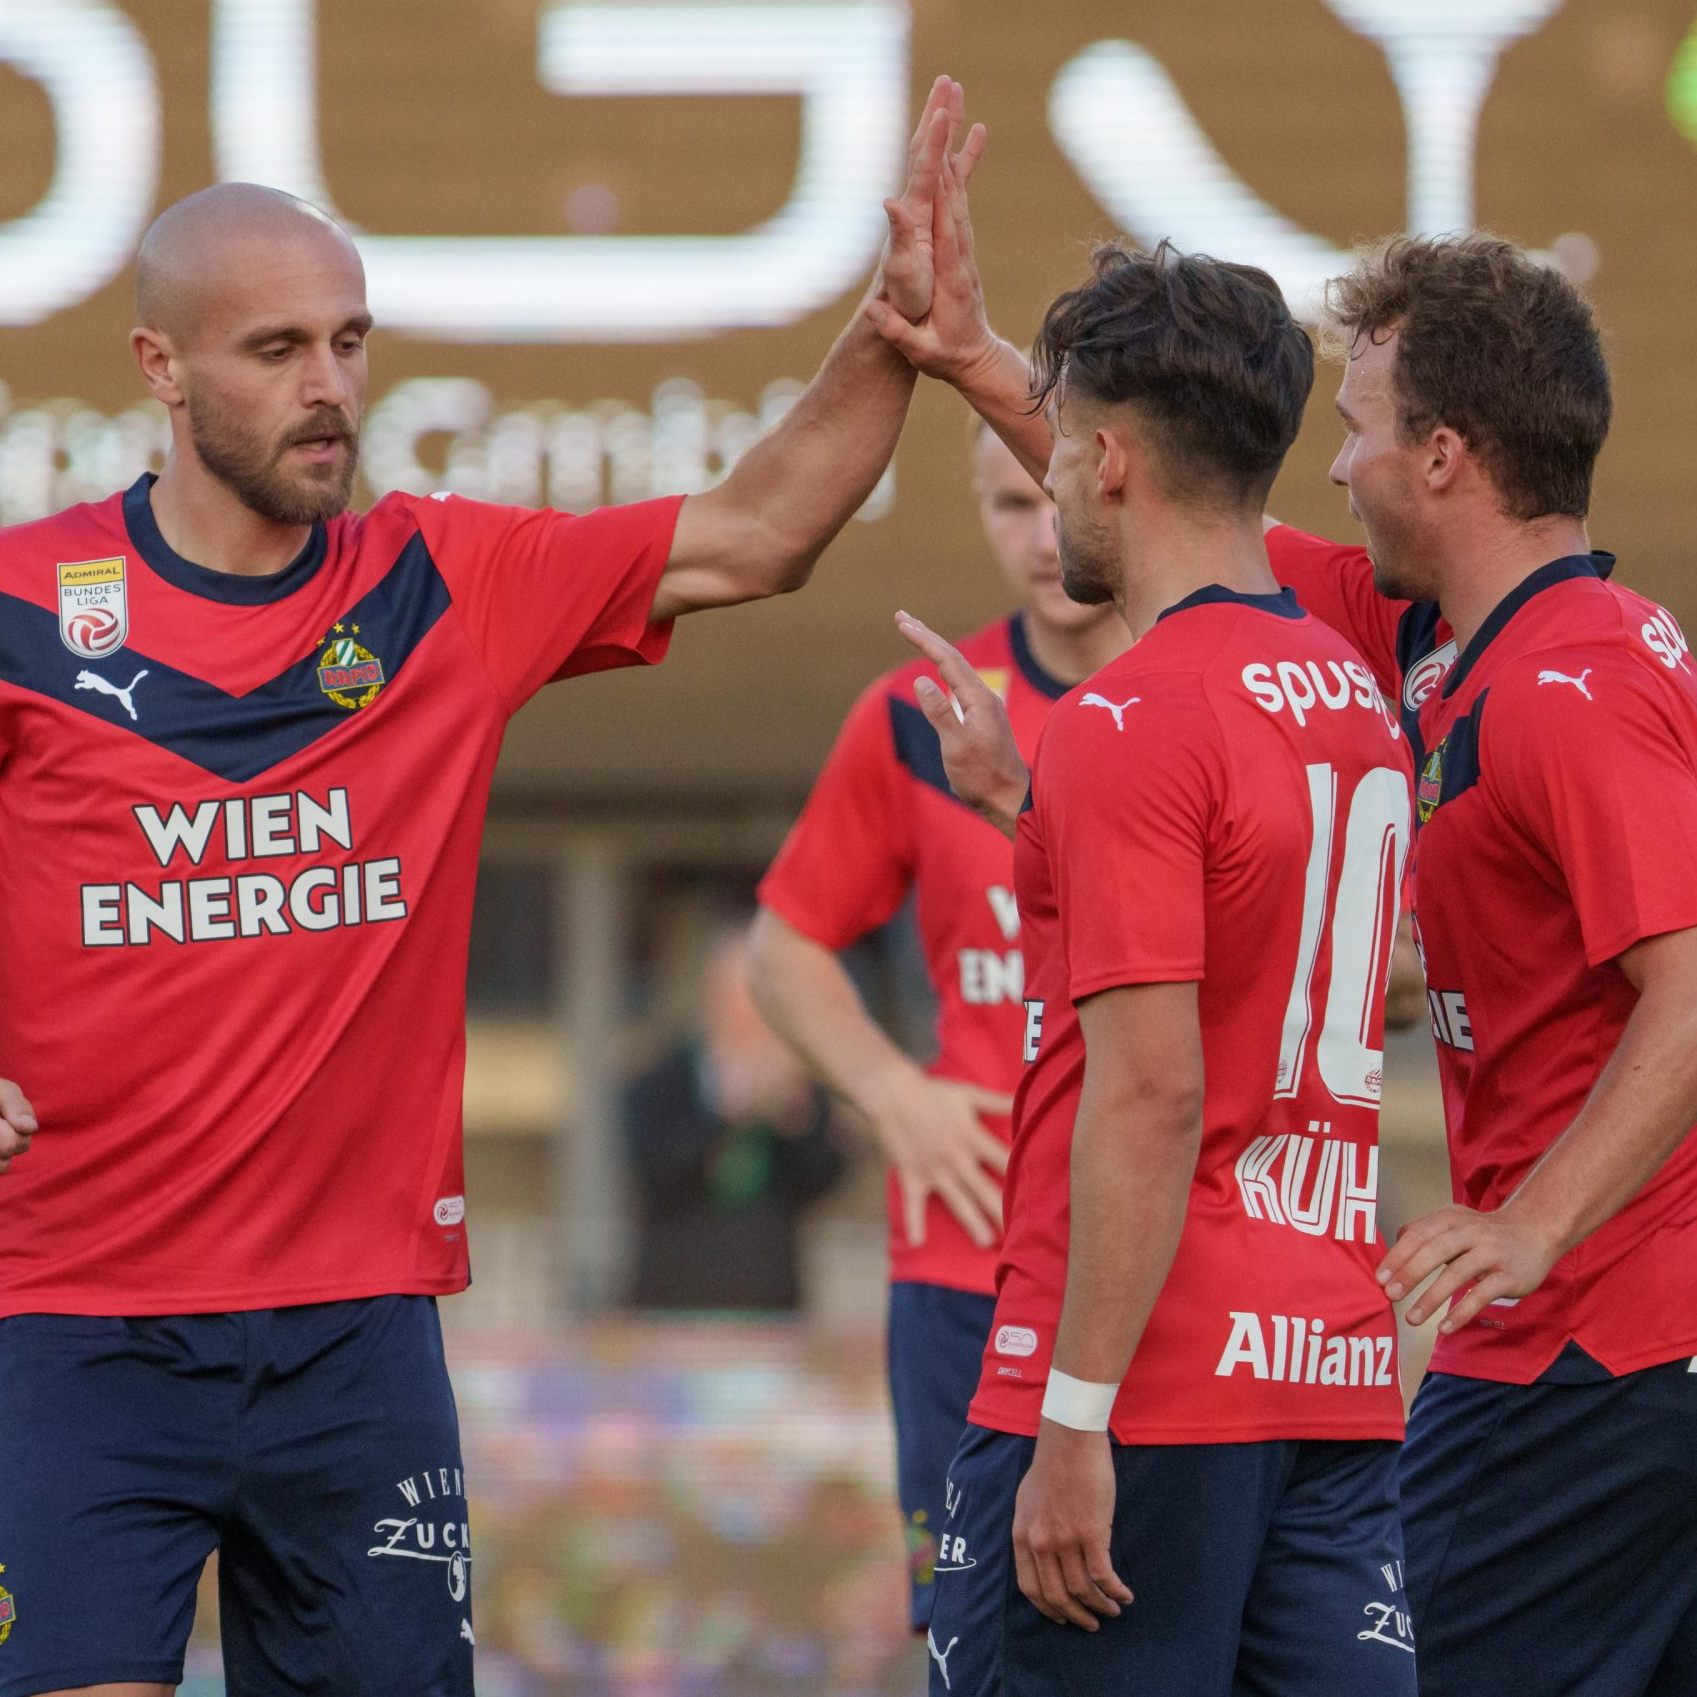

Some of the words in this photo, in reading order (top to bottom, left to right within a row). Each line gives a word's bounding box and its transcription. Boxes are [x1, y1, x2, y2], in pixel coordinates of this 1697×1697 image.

[64, 567, 120, 579] ADMIRAL
[64, 583, 121, 597] BUNDES
[77, 596, 109, 606] LIGA
[133, 787, 353, 868] WIEN
[80, 857, 408, 948] ENERGIE
[1273, 763, 1411, 1110] 10
[1234, 1120, 1379, 1245] KÜH
[1214, 1311, 1393, 1387] Allianz
[396, 1467, 468, 1507] WIEN
